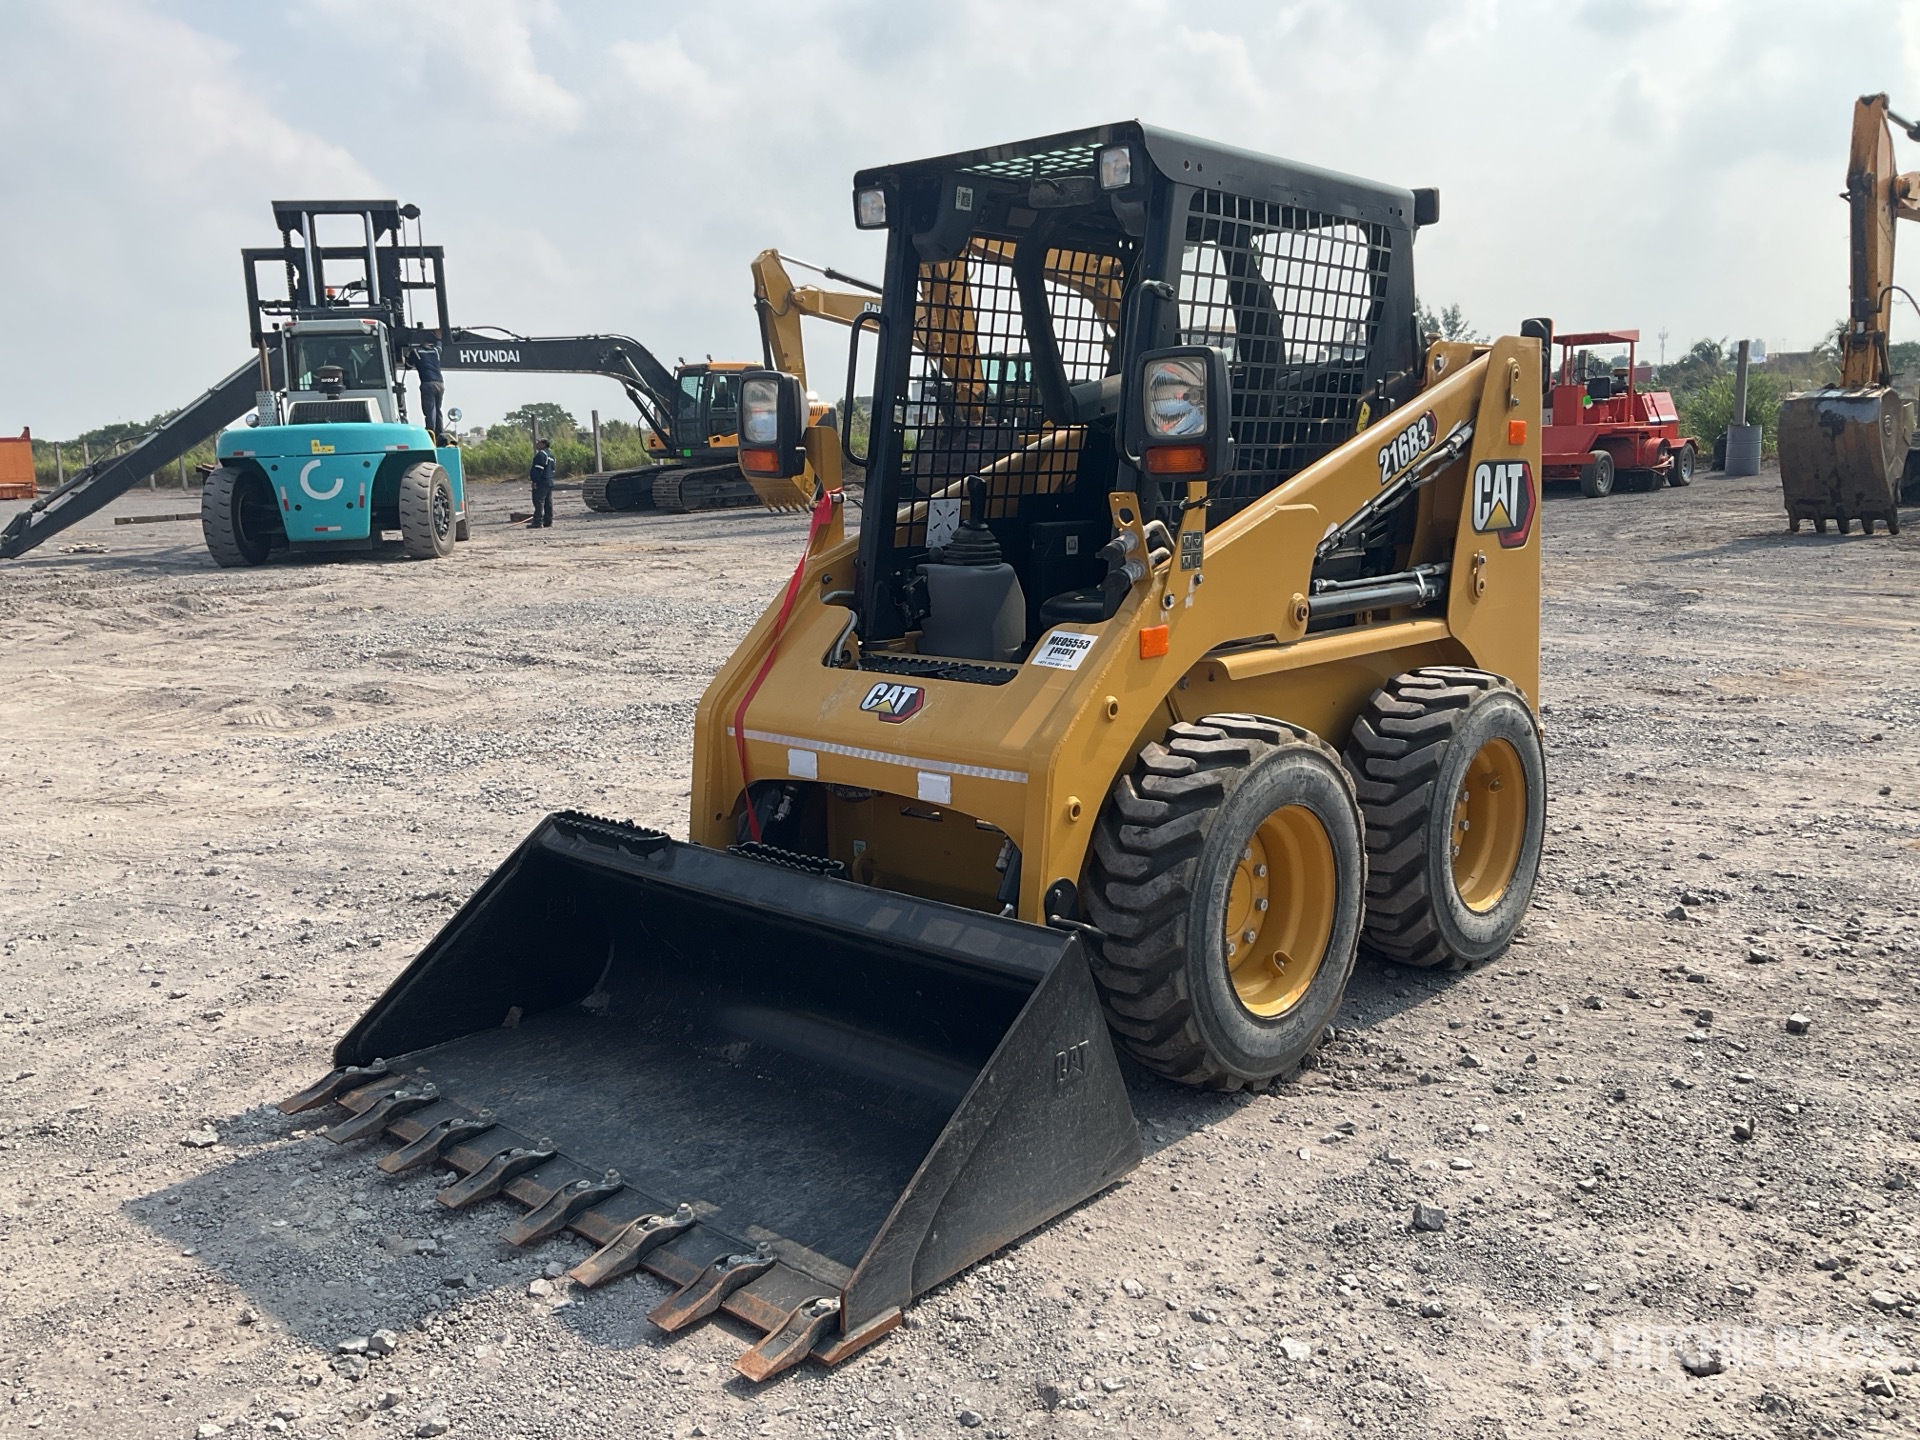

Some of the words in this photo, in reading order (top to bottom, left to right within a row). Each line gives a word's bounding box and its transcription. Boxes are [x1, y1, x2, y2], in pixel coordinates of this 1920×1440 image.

[460, 350, 520, 363] HYUNDAI
[1379, 417, 1430, 483] 216B3
[1473, 463, 1523, 531] CAT
[861, 682, 919, 714] CAT
[1055, 1039, 1090, 1084] CAT
